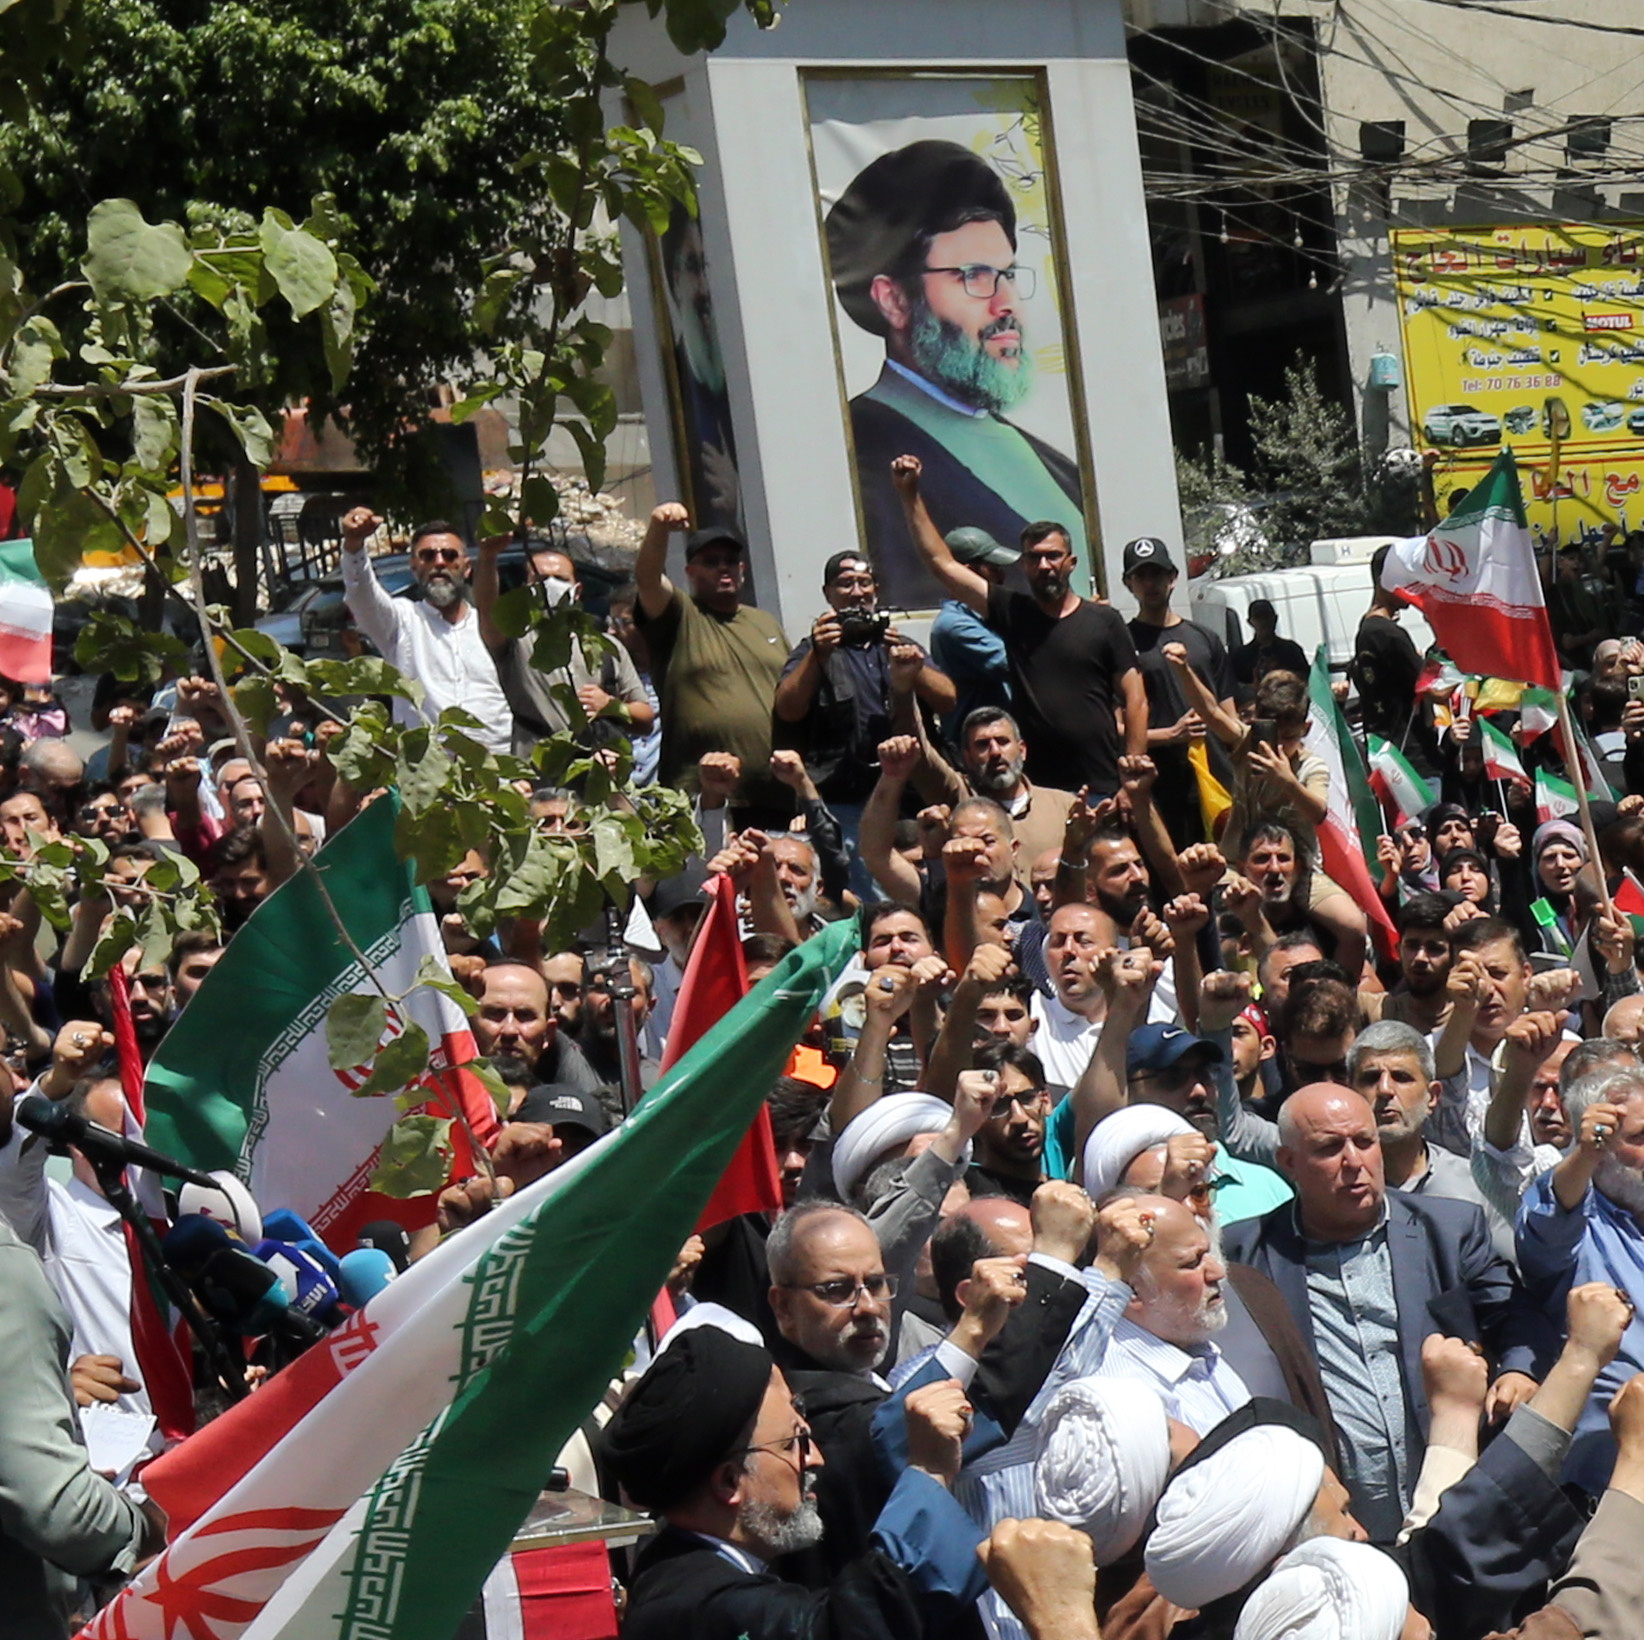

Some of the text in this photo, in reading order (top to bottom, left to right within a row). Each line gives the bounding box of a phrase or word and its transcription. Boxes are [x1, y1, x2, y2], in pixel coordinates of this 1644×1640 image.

[1586, 315, 1632, 330] MOTUL
[1462, 374, 1561, 393] Tel: 70 76 36 88
[1605, 472, 1642, 507] مع
